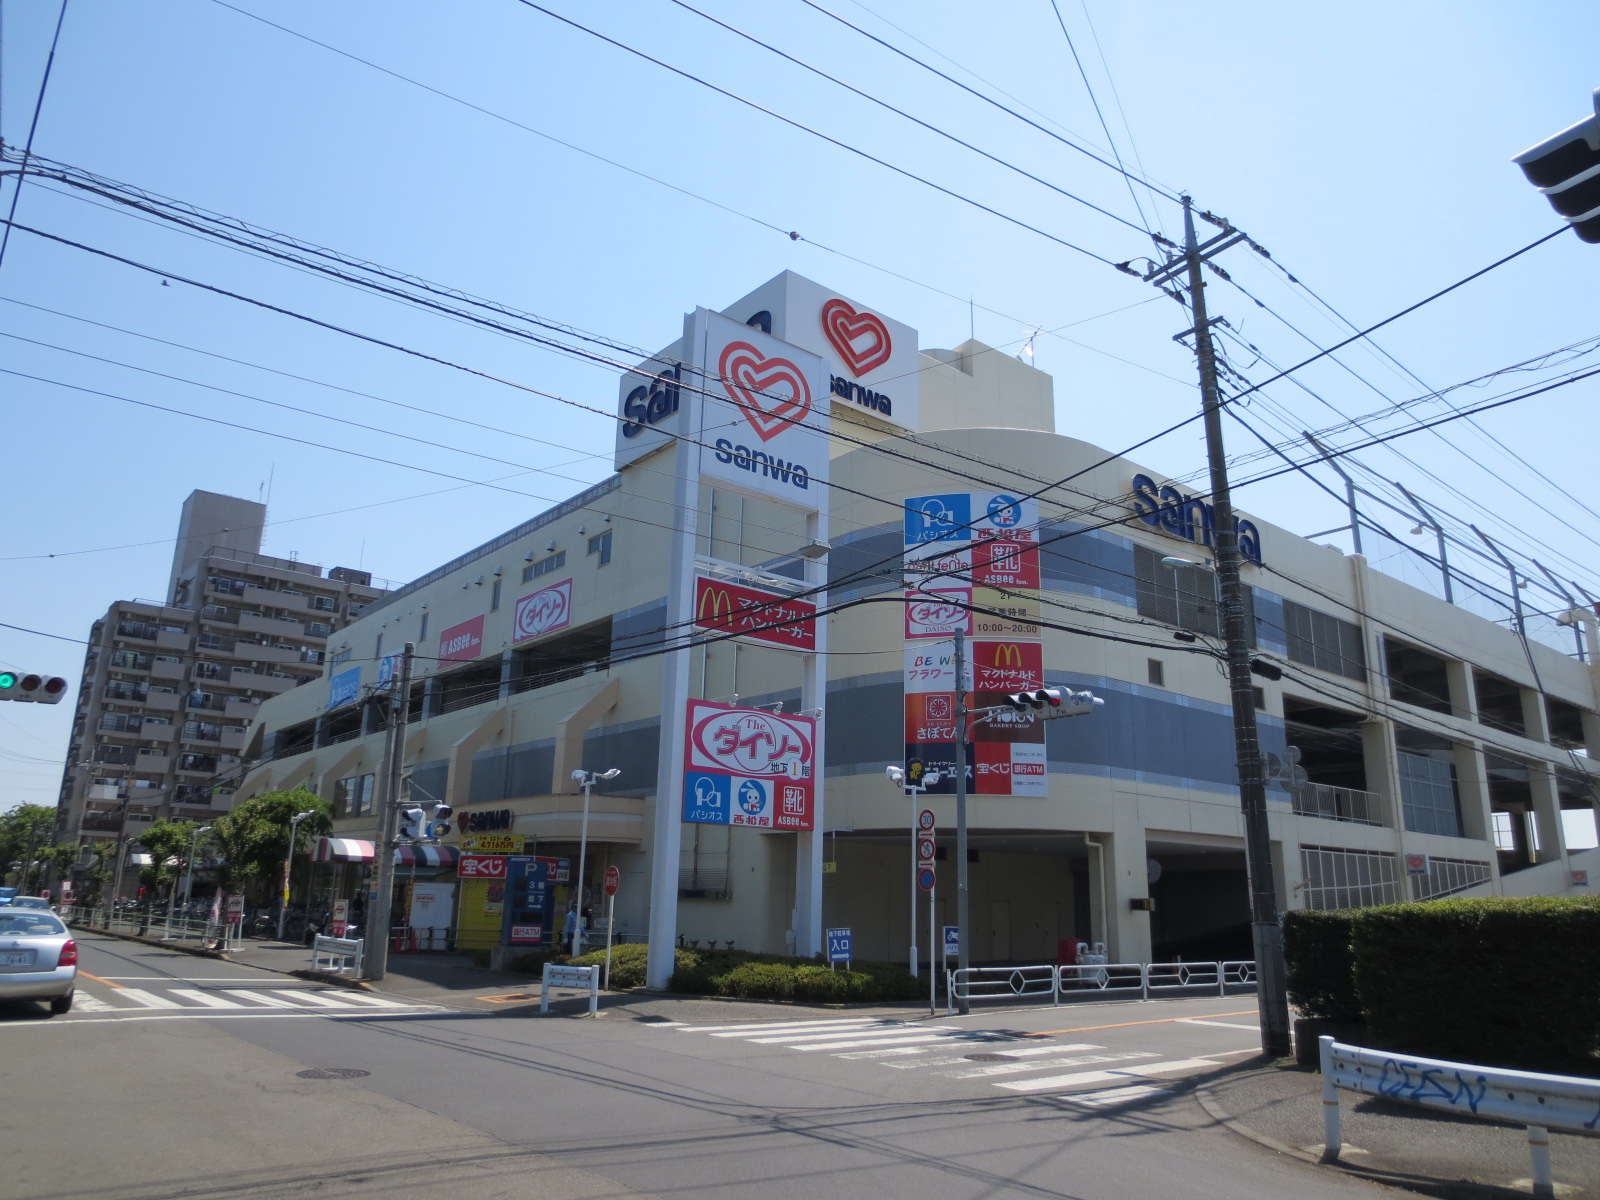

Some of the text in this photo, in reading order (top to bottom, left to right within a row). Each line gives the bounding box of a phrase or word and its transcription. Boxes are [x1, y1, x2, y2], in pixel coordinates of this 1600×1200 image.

[715, 438, 809, 490] sanwa
[916, 529, 959, 542] パシオス
[978, 528, 1032, 540] 西松屋
[984, 574, 1014, 584] ASBee
[526, 598, 562, 629] ダイソー
[916, 606, 964, 621] ダイソー
[925, 625, 952, 633] DAISO
[447, 632, 471, 655] ASBee
[915, 656, 933, 667] BE
[909, 668, 970, 680] フラワー
[980, 670, 1036, 680] マクドナルド
[978, 681, 1039, 690] ハンバーガー
[745, 719, 766, 731] The
[917, 726, 957, 740] さぼてん
[713, 725, 801, 760] ダイソー
[976, 763, 1010, 774] 宝くじ
[1013, 764, 1043, 774] 銀行ATM
[785, 788, 803, 812] 靴
[690, 809, 723, 821] パシオス
[733, 814, 770, 826] 西松屋
[777, 815, 800, 826] ASBee
[922, 815, 931, 825] 30
[462, 859, 503, 875] 宝くじ
[525, 863, 538, 877] P
[513, 928, 541, 937] 銀行ATM
[831, 939, 849, 952] 入口
